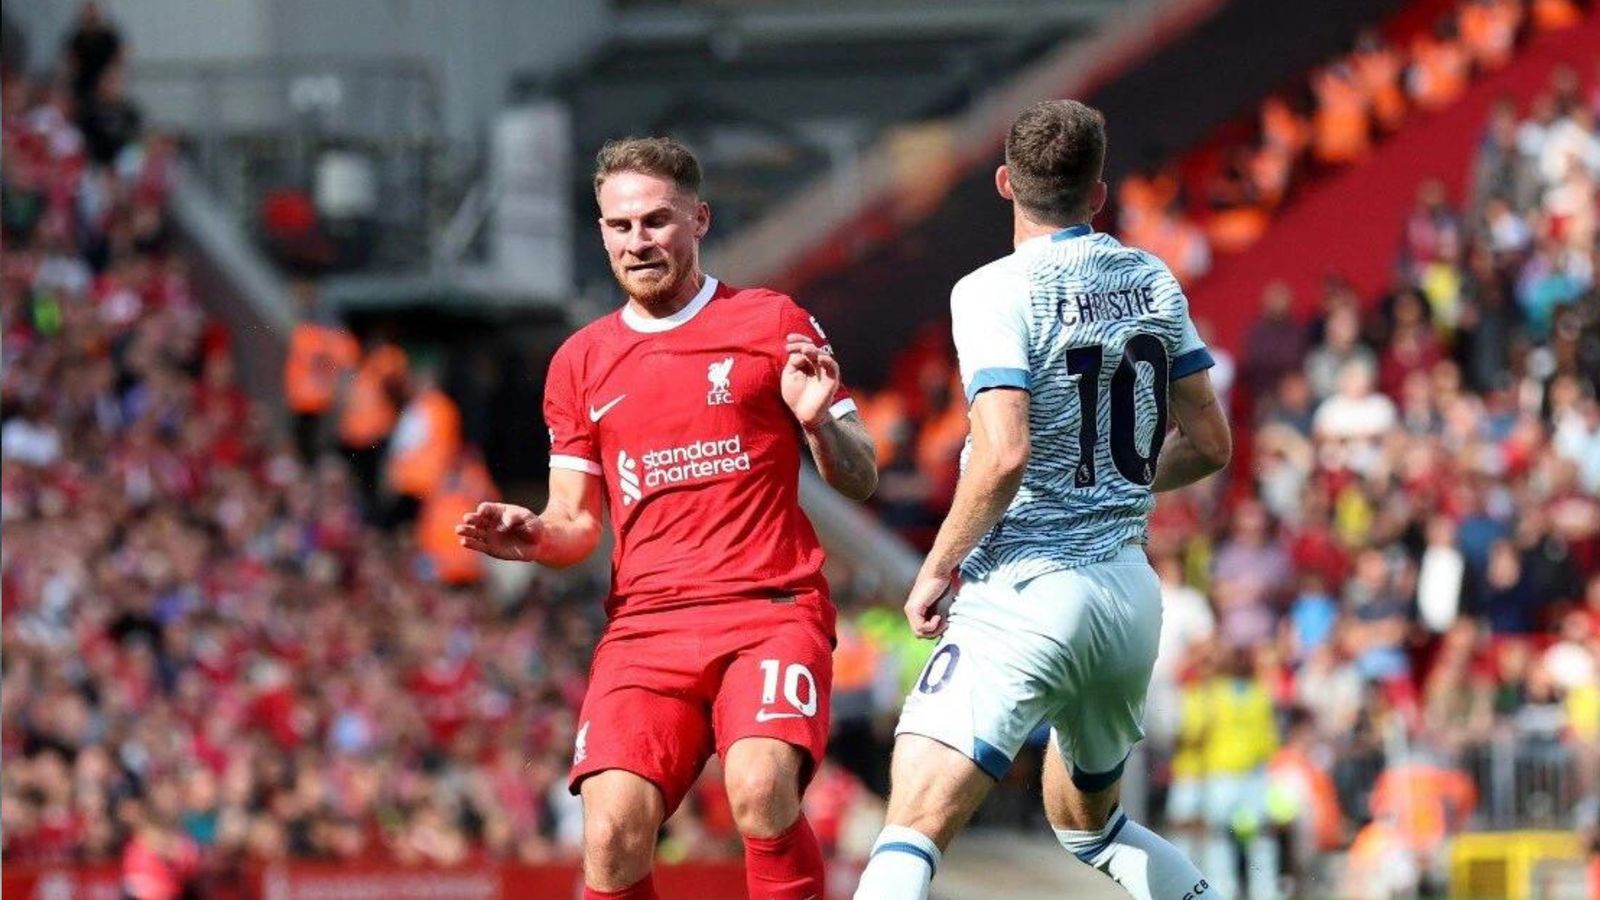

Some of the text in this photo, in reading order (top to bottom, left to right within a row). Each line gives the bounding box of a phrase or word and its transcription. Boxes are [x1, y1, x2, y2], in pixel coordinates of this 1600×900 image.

[1057, 287, 1159, 327] CHRISTIE
[1065, 333, 1169, 488] 10
[642, 435, 740, 469] standard
[645, 453, 750, 487] chartered
[760, 659, 817, 717] 10
